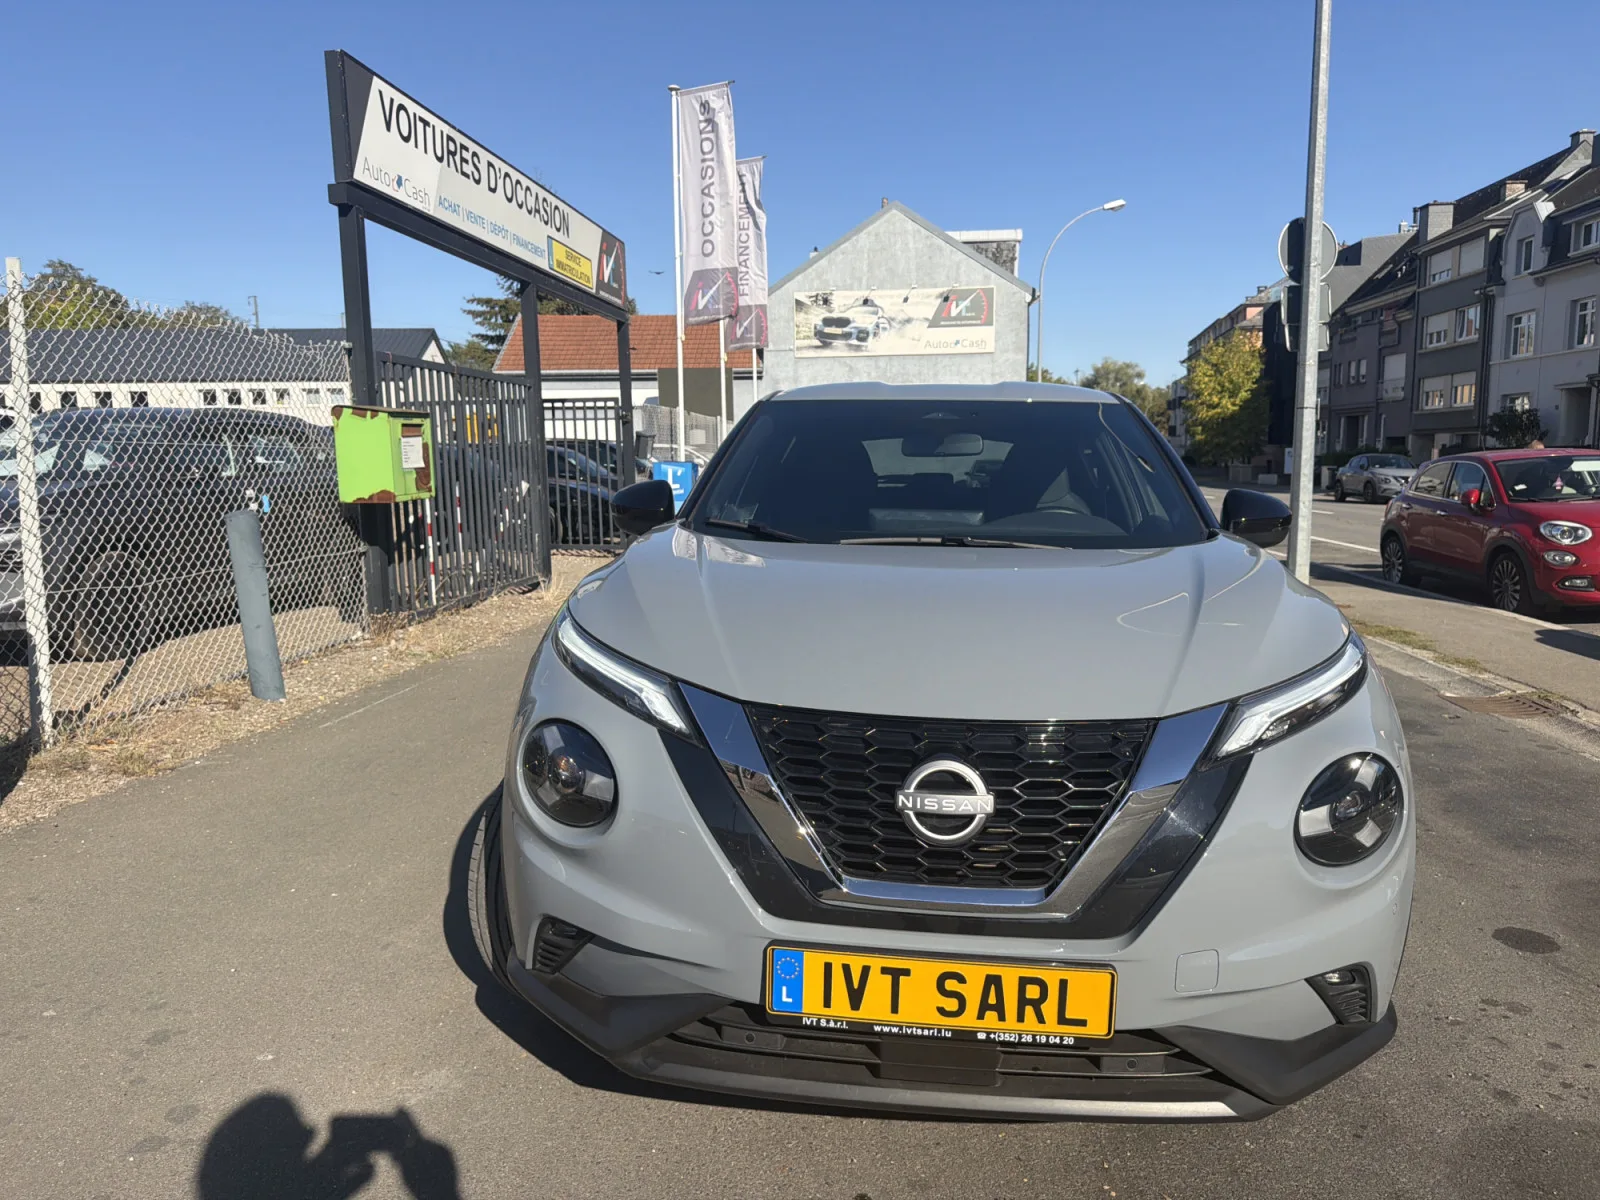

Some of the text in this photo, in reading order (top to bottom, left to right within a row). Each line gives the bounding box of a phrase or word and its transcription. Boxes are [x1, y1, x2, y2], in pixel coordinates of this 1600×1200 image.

[378, 89, 570, 239] VOITURES D'OCCASION
[362, 156, 431, 206] Auto Cash
[699, 99, 715, 257] OCCASIONS
[438, 195, 461, 217] ACHAT
[465, 208, 486, 230] VENTE
[512, 233, 546, 260] FINANCEMENT
[924, 338, 986, 349] Auto Cash
[898, 795, 991, 811] NISSAN
[781, 985, 793, 1003] L
[823, 961, 1088, 1027] IVT SARL
[802, 1017, 818, 1026] IVT
[873, 1024, 952, 1037] www.ivtsarl.lu
[989, 1033, 1074, 1045] +(352) 26 19 04 20
